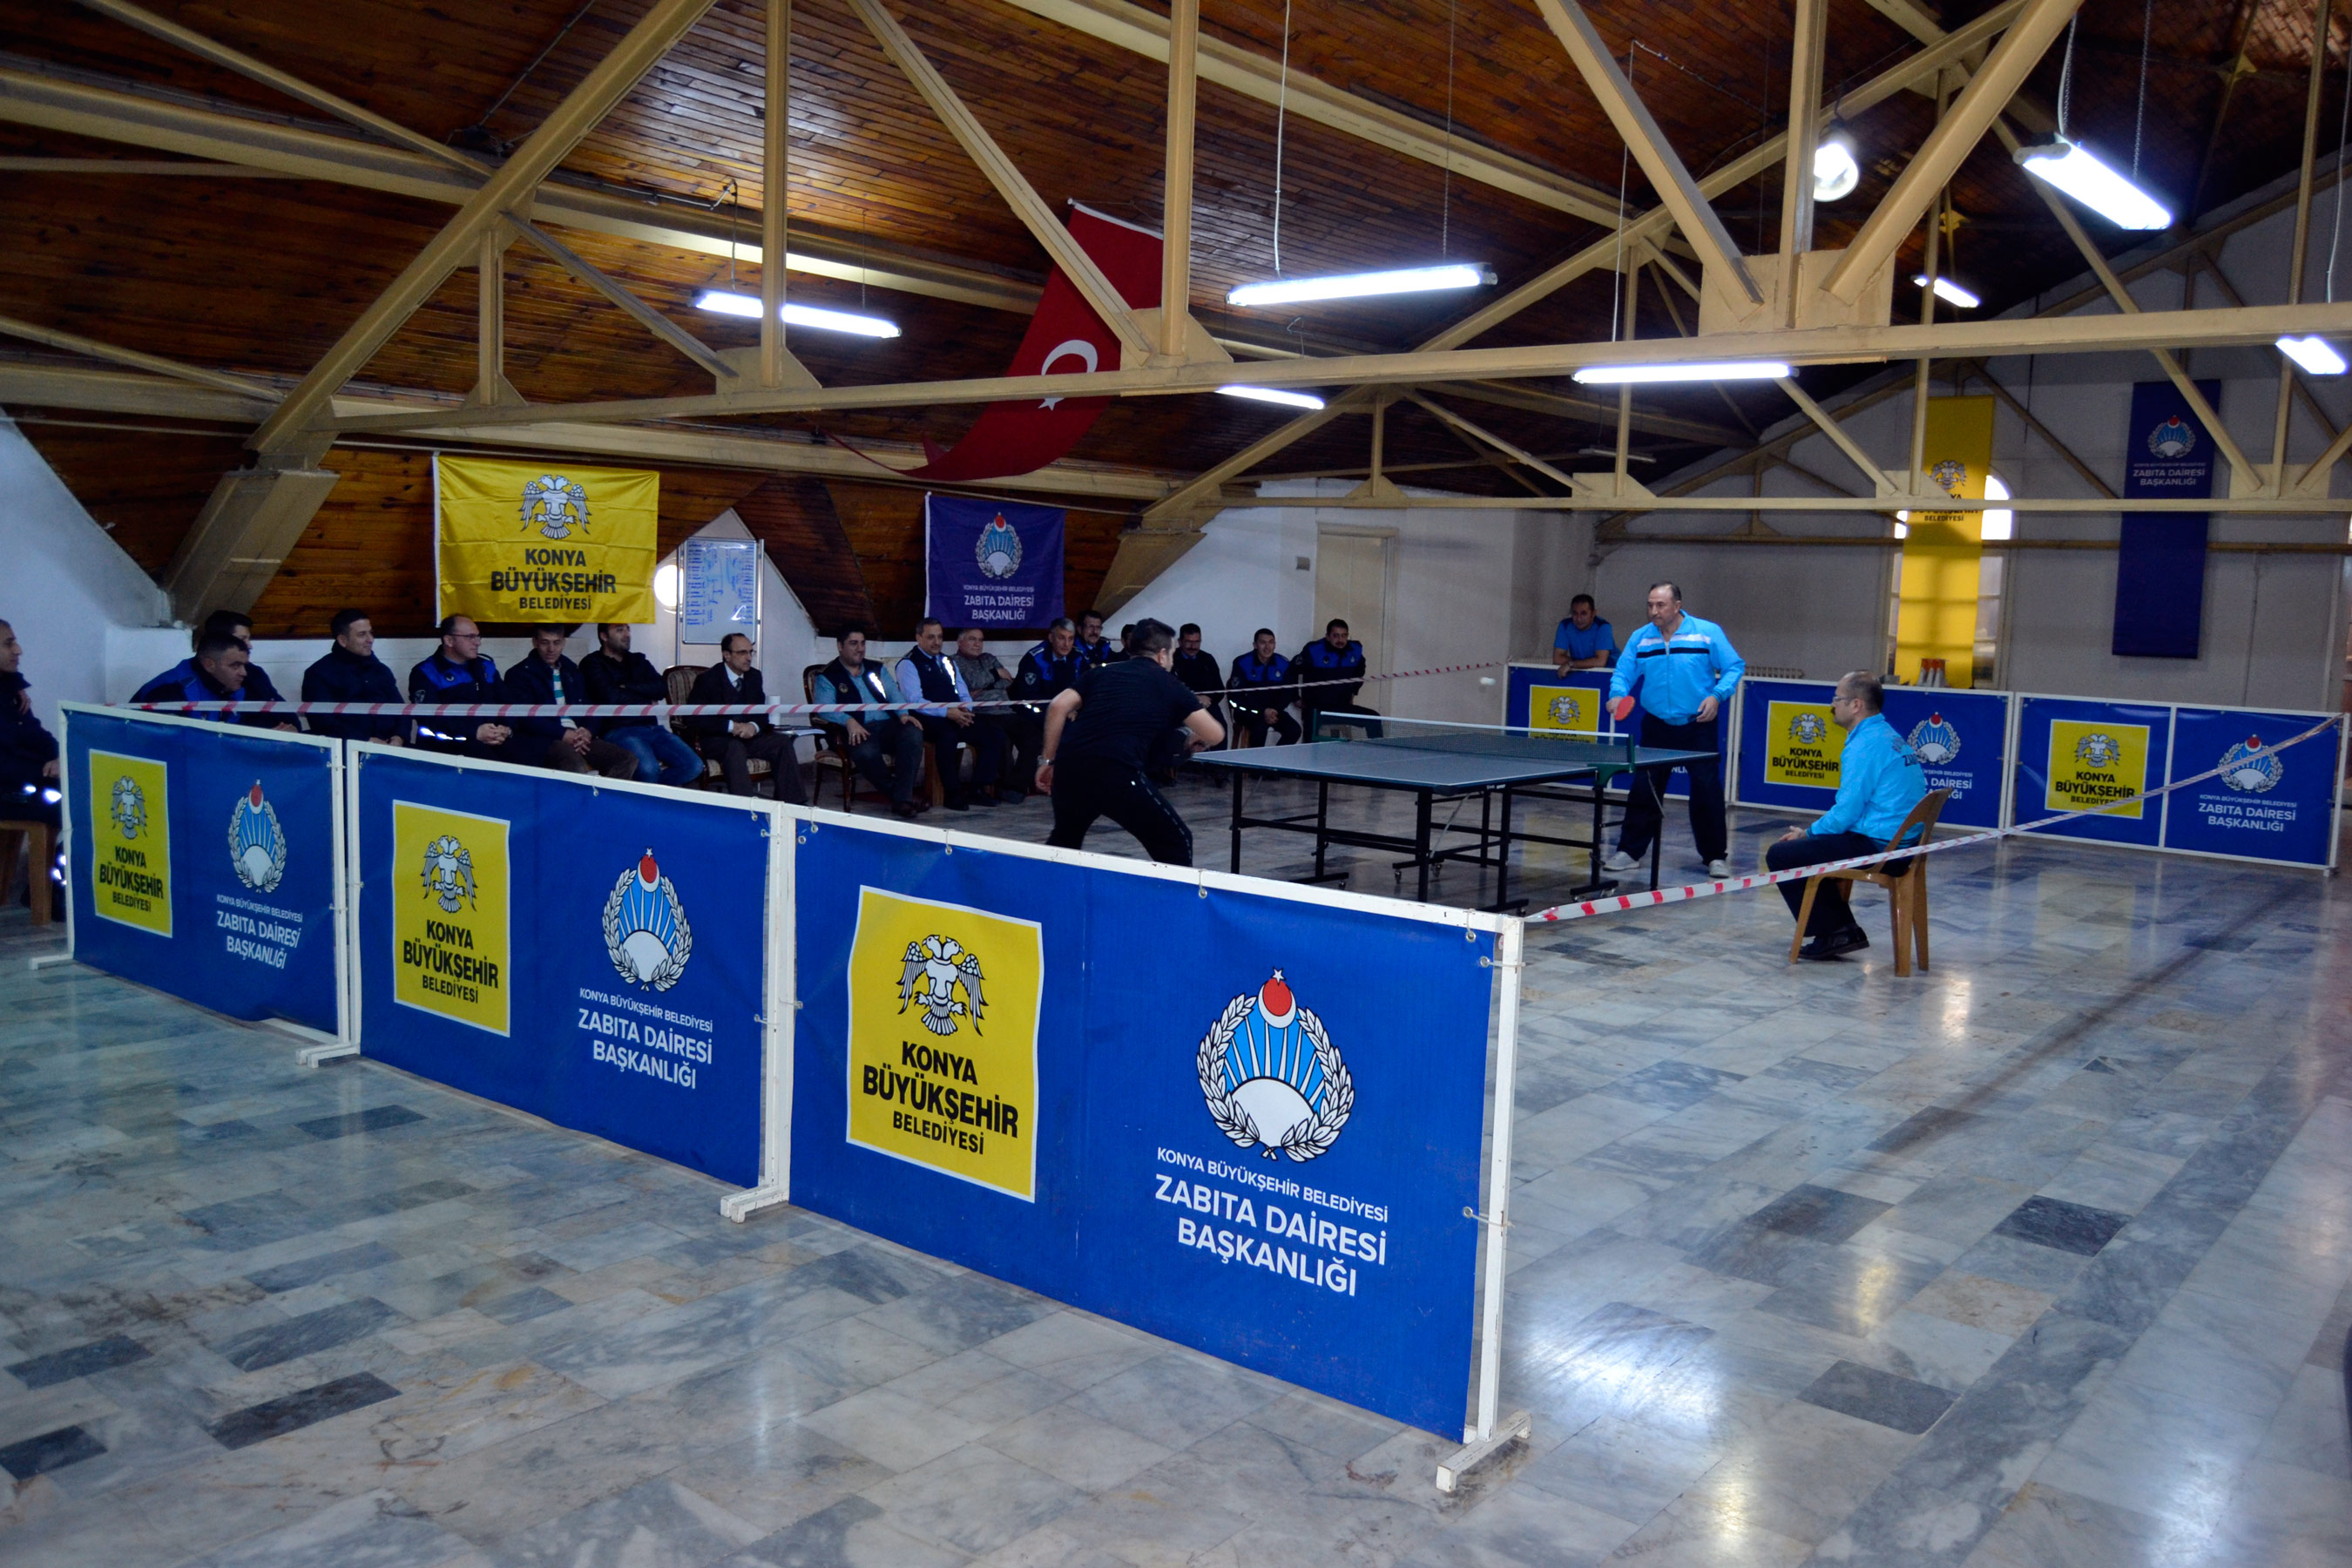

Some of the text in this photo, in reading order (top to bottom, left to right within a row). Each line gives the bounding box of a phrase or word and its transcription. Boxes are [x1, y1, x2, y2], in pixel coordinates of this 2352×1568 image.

[525, 548, 586, 567] KONYA
[490, 566, 617, 596] BÜYÜKŞEHİR
[519, 594, 591, 610] BELEDİYESİ
[964, 594, 1034, 607] ZABITA DAİRESİ
[971, 608, 1025, 623] BAŞKANLIĞI
[1772, 754, 1839, 772] BÜYÜKŞEHİR
[1789, 747, 1822, 758] KONYA
[1785, 769, 1825, 779] BELEDİYESİ
[1930, 776, 1972, 789] DAİRESİ
[2055, 780, 2135, 798] BÜYÜKŞEHİR
[2076, 771, 2115, 783] KONYA
[2199, 802, 2296, 821] ZABITA DAİRESİ
[2208, 815, 2284, 832] BAŞKANLIĞI
[115, 846, 146, 868] KONYA
[99, 861, 164, 899] BÜYÜKŞEHİR
[112, 891, 152, 912] BELEDİYESİ
[217, 910, 302, 948] ZABITA DAİRESİ
[426, 919, 474, 950] KONYA
[226, 935, 287, 970] BAŞKANLIĞI
[403, 936, 499, 989] BÜYÜKŞEHİR
[422, 974, 478, 1004] BELEDİYESİ
[579, 987, 713, 1033] KONYA BÜYÜKŞEHİR BELEDİYESİ
[578, 1008, 713, 1064] ZABITA DAİRESİ
[593, 1039, 696, 1089] BAŞKANLIĞI
[902, 1041, 978, 1085] KONYA
[863, 1062, 1018, 1139] BÜYÜKŞEHİR
[893, 1110, 984, 1155] BELEDİYESİ
[1157, 1146, 1388, 1223] KONYA BÜYÜKŞEHİR BELEDİYESİ
[1155, 1173, 1386, 1266] ZABITA DAİRESİ
[1178, 1217, 1356, 1297] BAŞKANLIĞI
